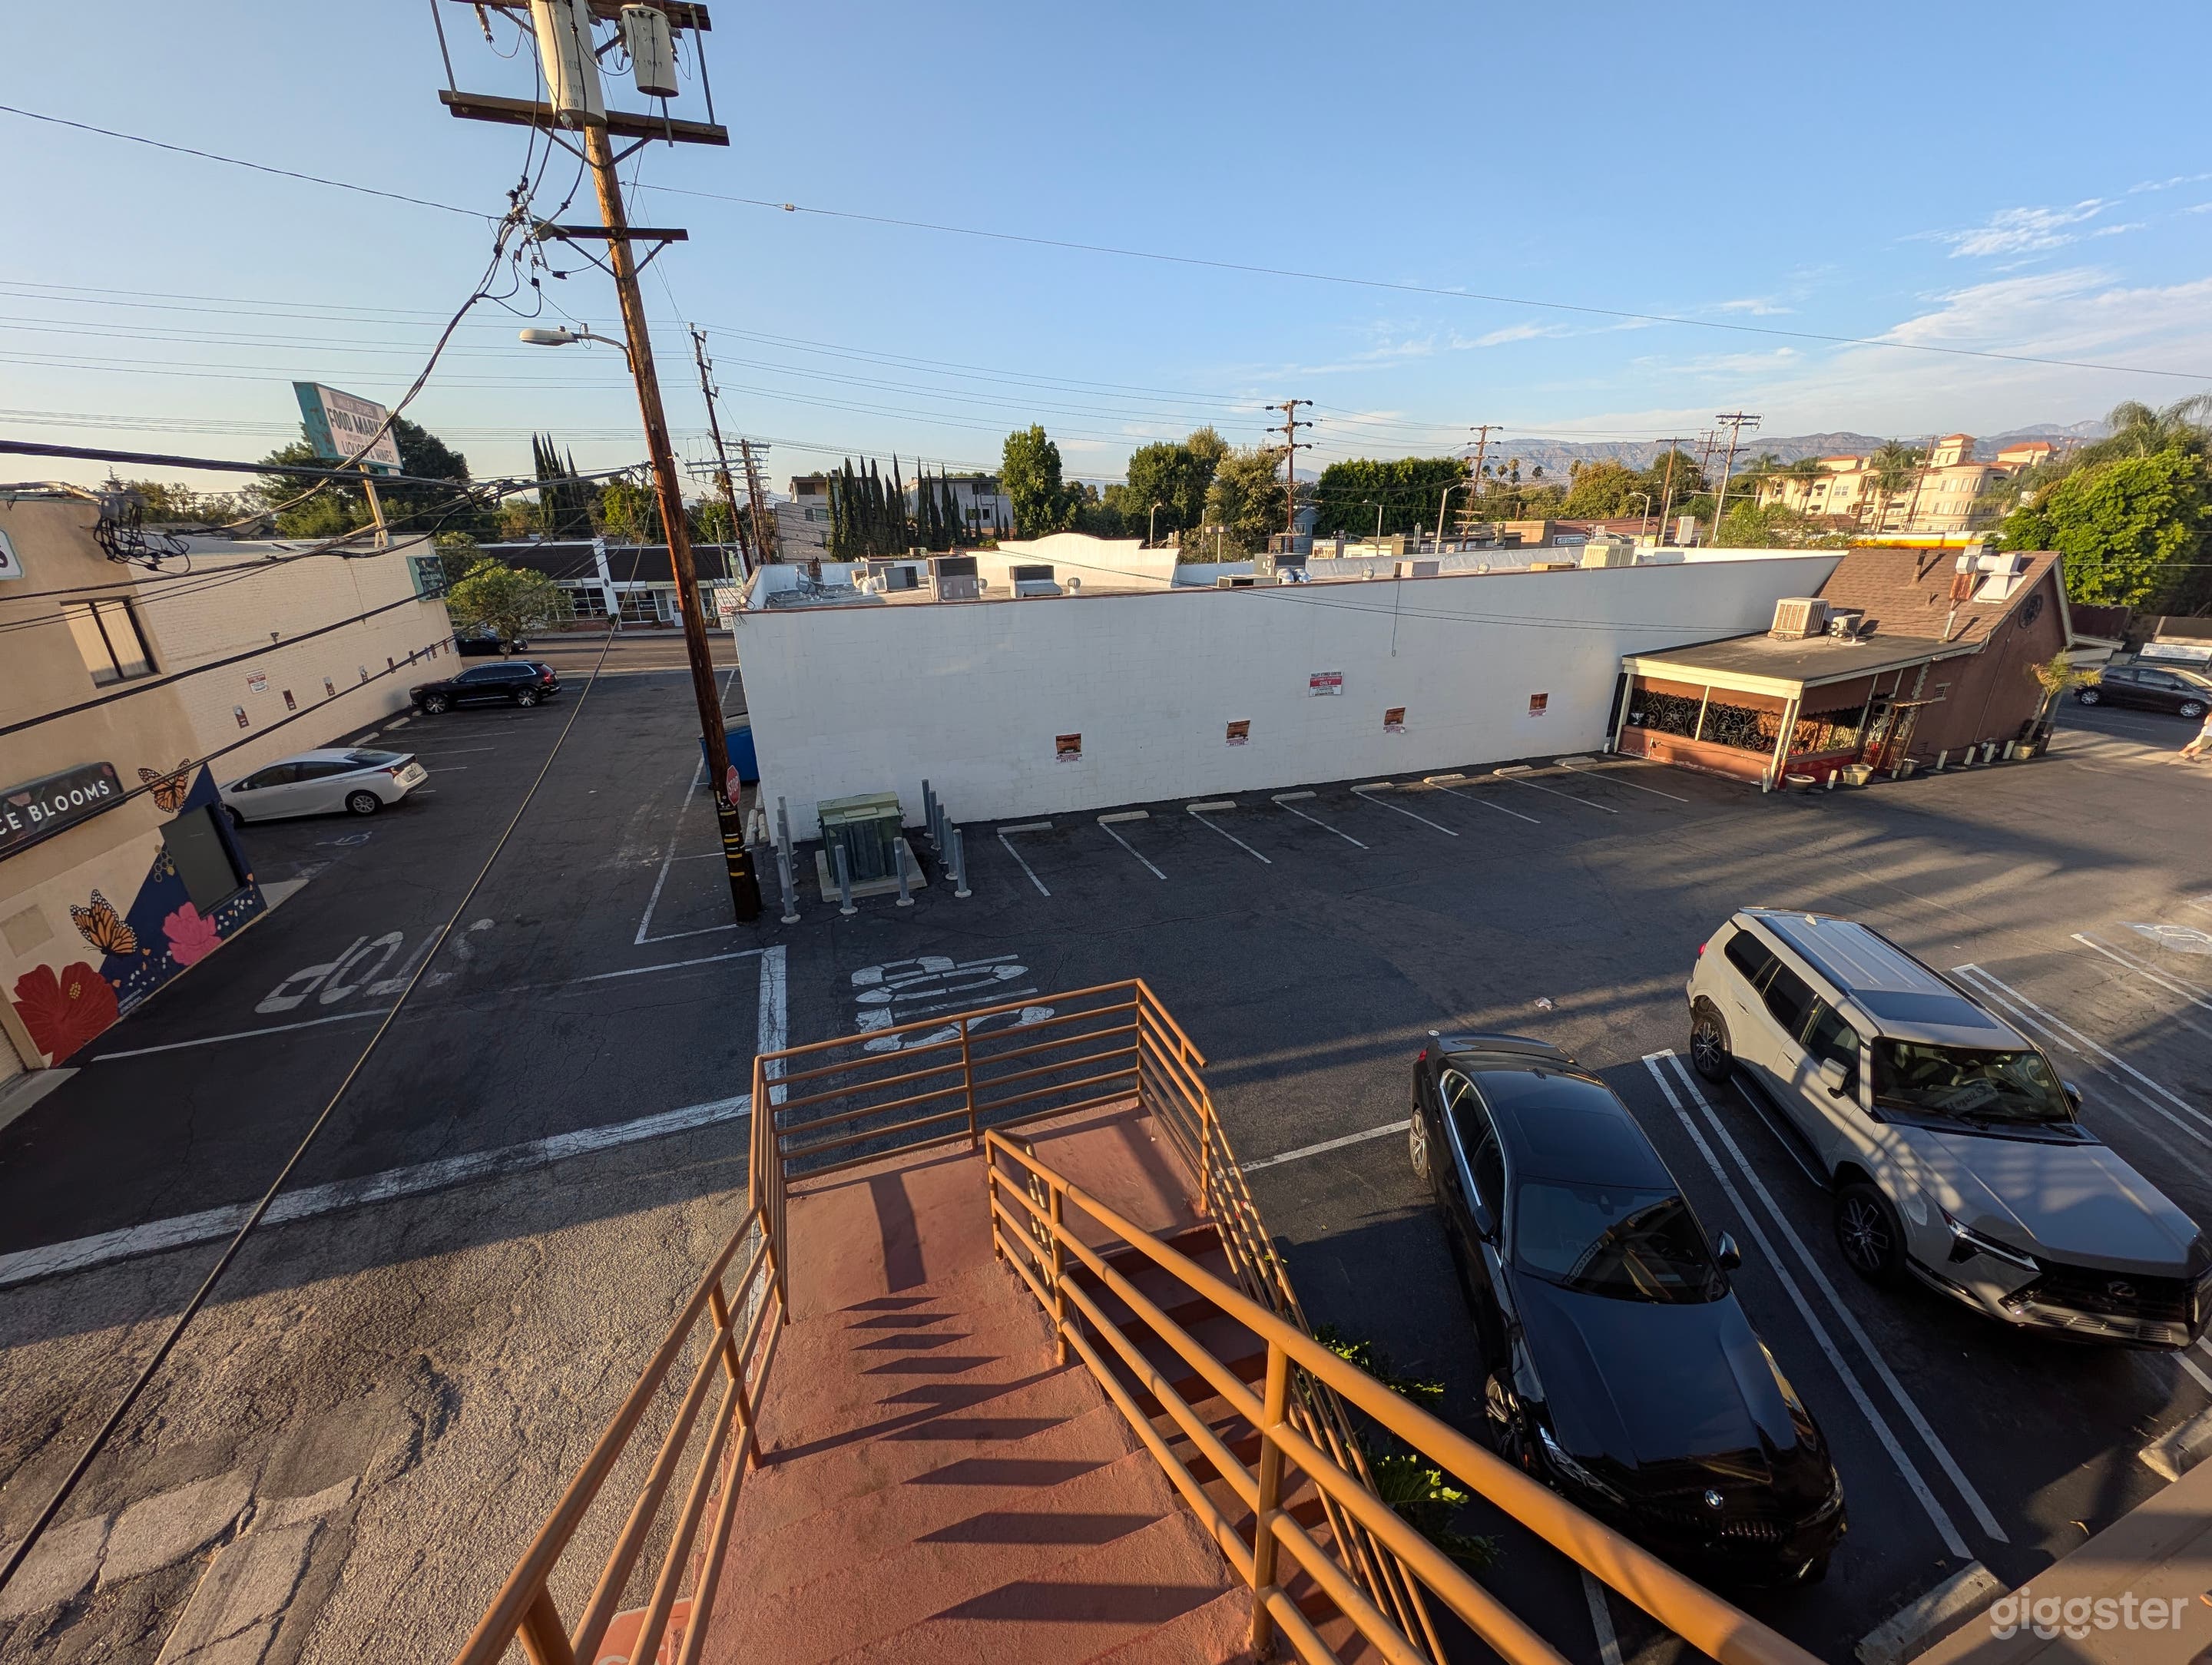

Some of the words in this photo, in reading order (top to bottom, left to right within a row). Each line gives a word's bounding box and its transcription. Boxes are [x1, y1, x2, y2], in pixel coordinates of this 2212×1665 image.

[565, 98, 579, 108] 100
[326, 407, 353, 432] FOOD
[341, 440, 369, 460] LIQUO
[374, 448, 395, 463] WINES
[728, 776, 739, 796] STOP
[28, 780, 111, 823] BLOOMS
[850, 954, 1055, 1051] STOP
